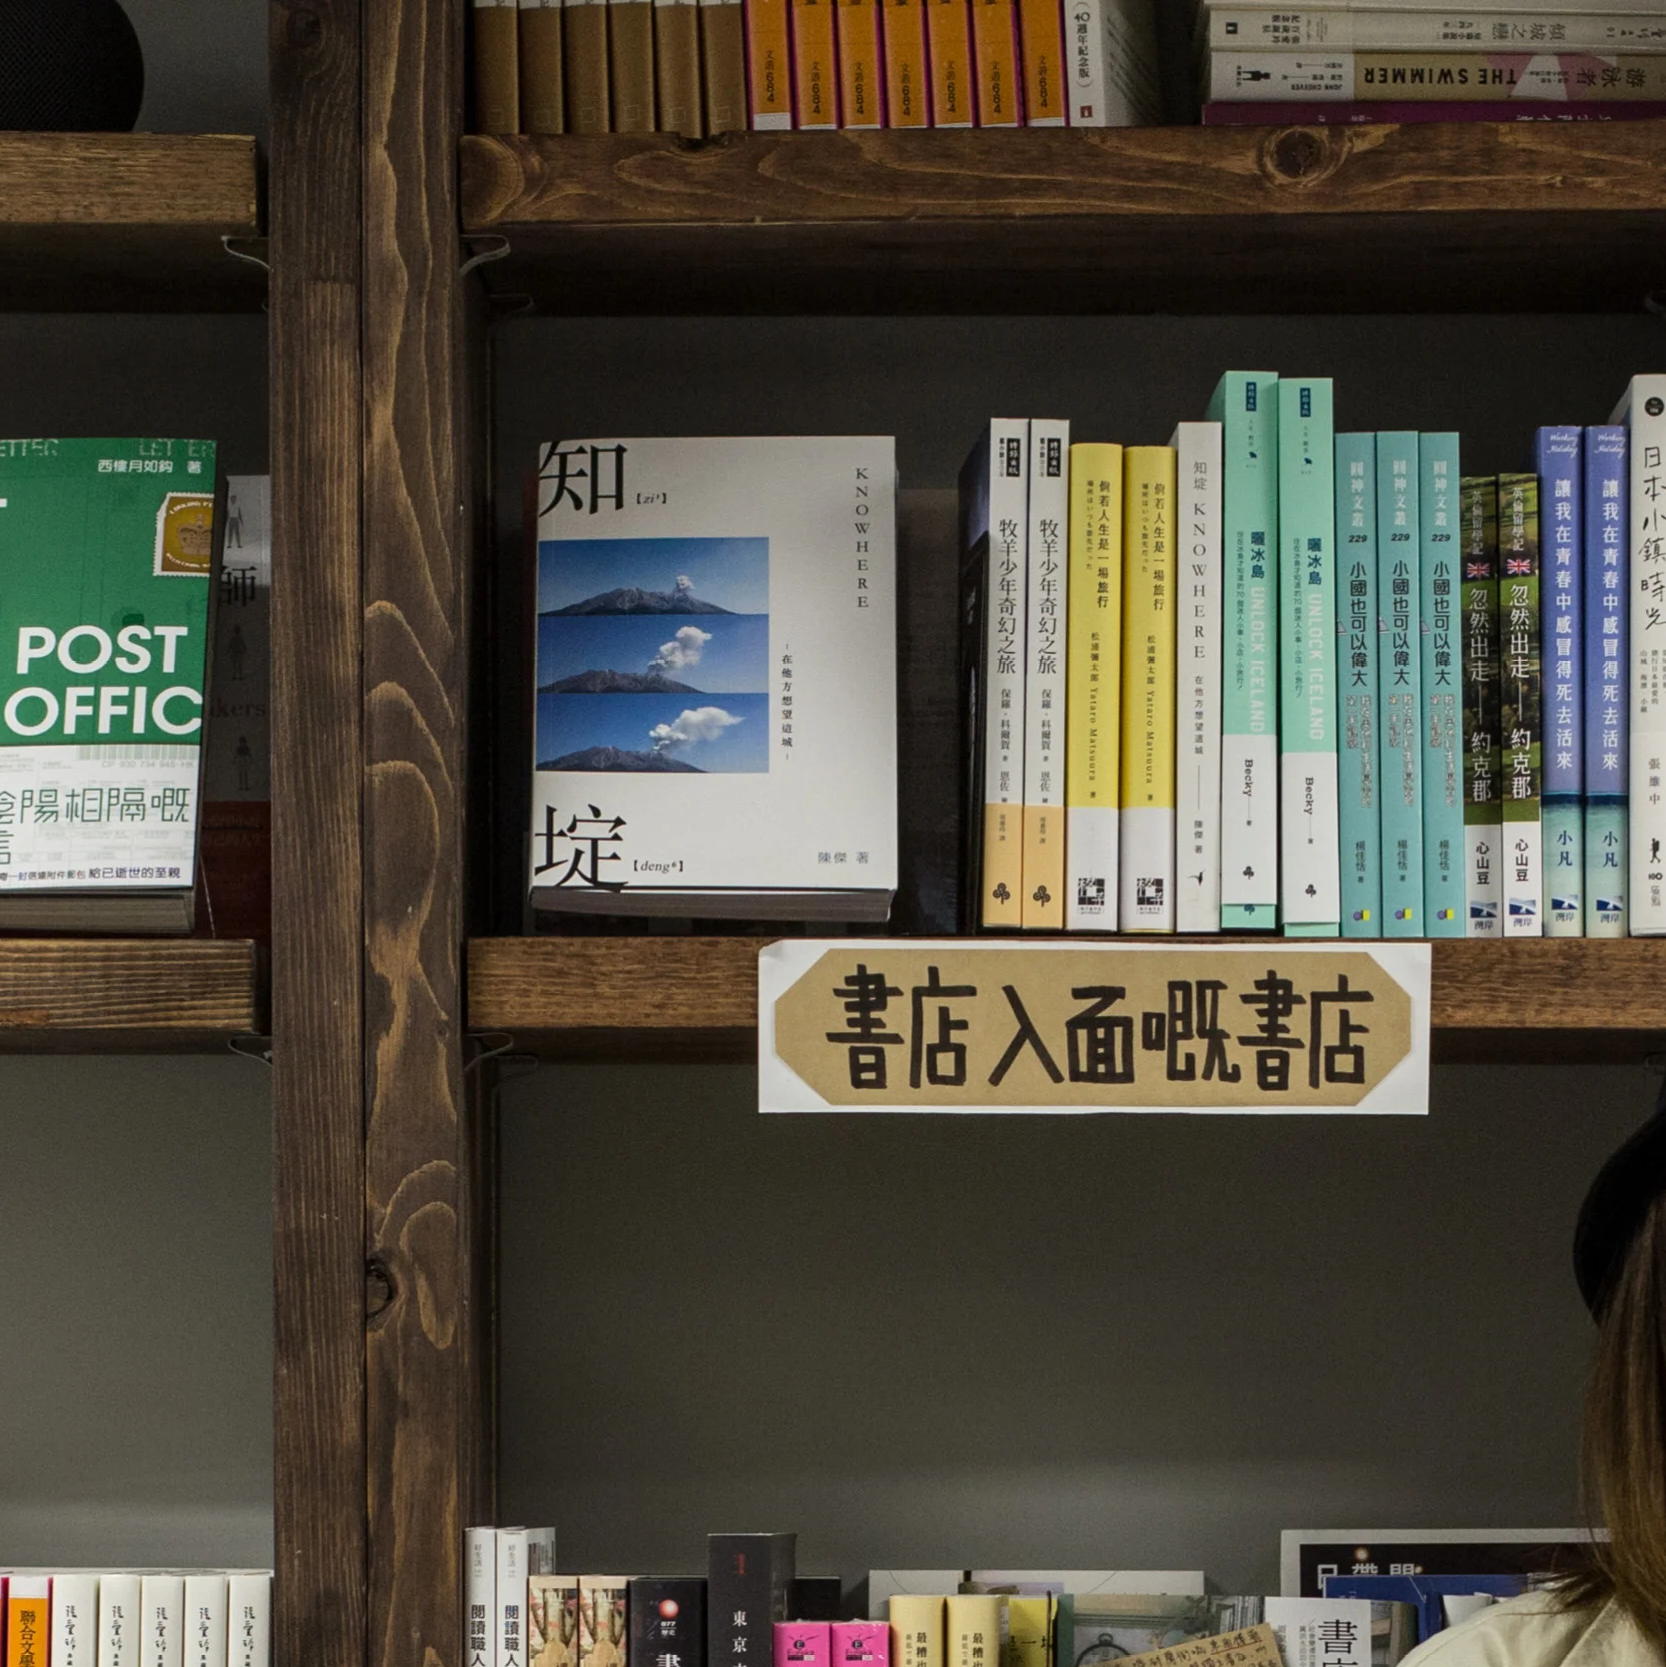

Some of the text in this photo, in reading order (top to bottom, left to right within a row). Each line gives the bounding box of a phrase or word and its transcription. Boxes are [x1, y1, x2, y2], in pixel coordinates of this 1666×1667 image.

[1478, 66, 1517, 86] THE
[539, 442, 627, 518] 知
[855, 468, 870, 609] KNOWHERE
[16, 627, 189, 675] POST
[998, 519, 1018, 672] 牧羊少年奇幻之旅
[1039, 519, 1059, 672] 牧羊少年奇幻之旅
[1351, 562, 1367, 687] 小國也可以偉大
[1393, 560, 1409, 686] 小國也可以偉大
[1554, 479, 1572, 770] 讓我在青春中感冒得死去活來
[1244, 759, 1253, 796] Becky
[1557, 831, 1573, 868] 小凡
[1602, 831, 1618, 868] 小凡
[825, 964, 1374, 1090] 書店入面嘅書店
